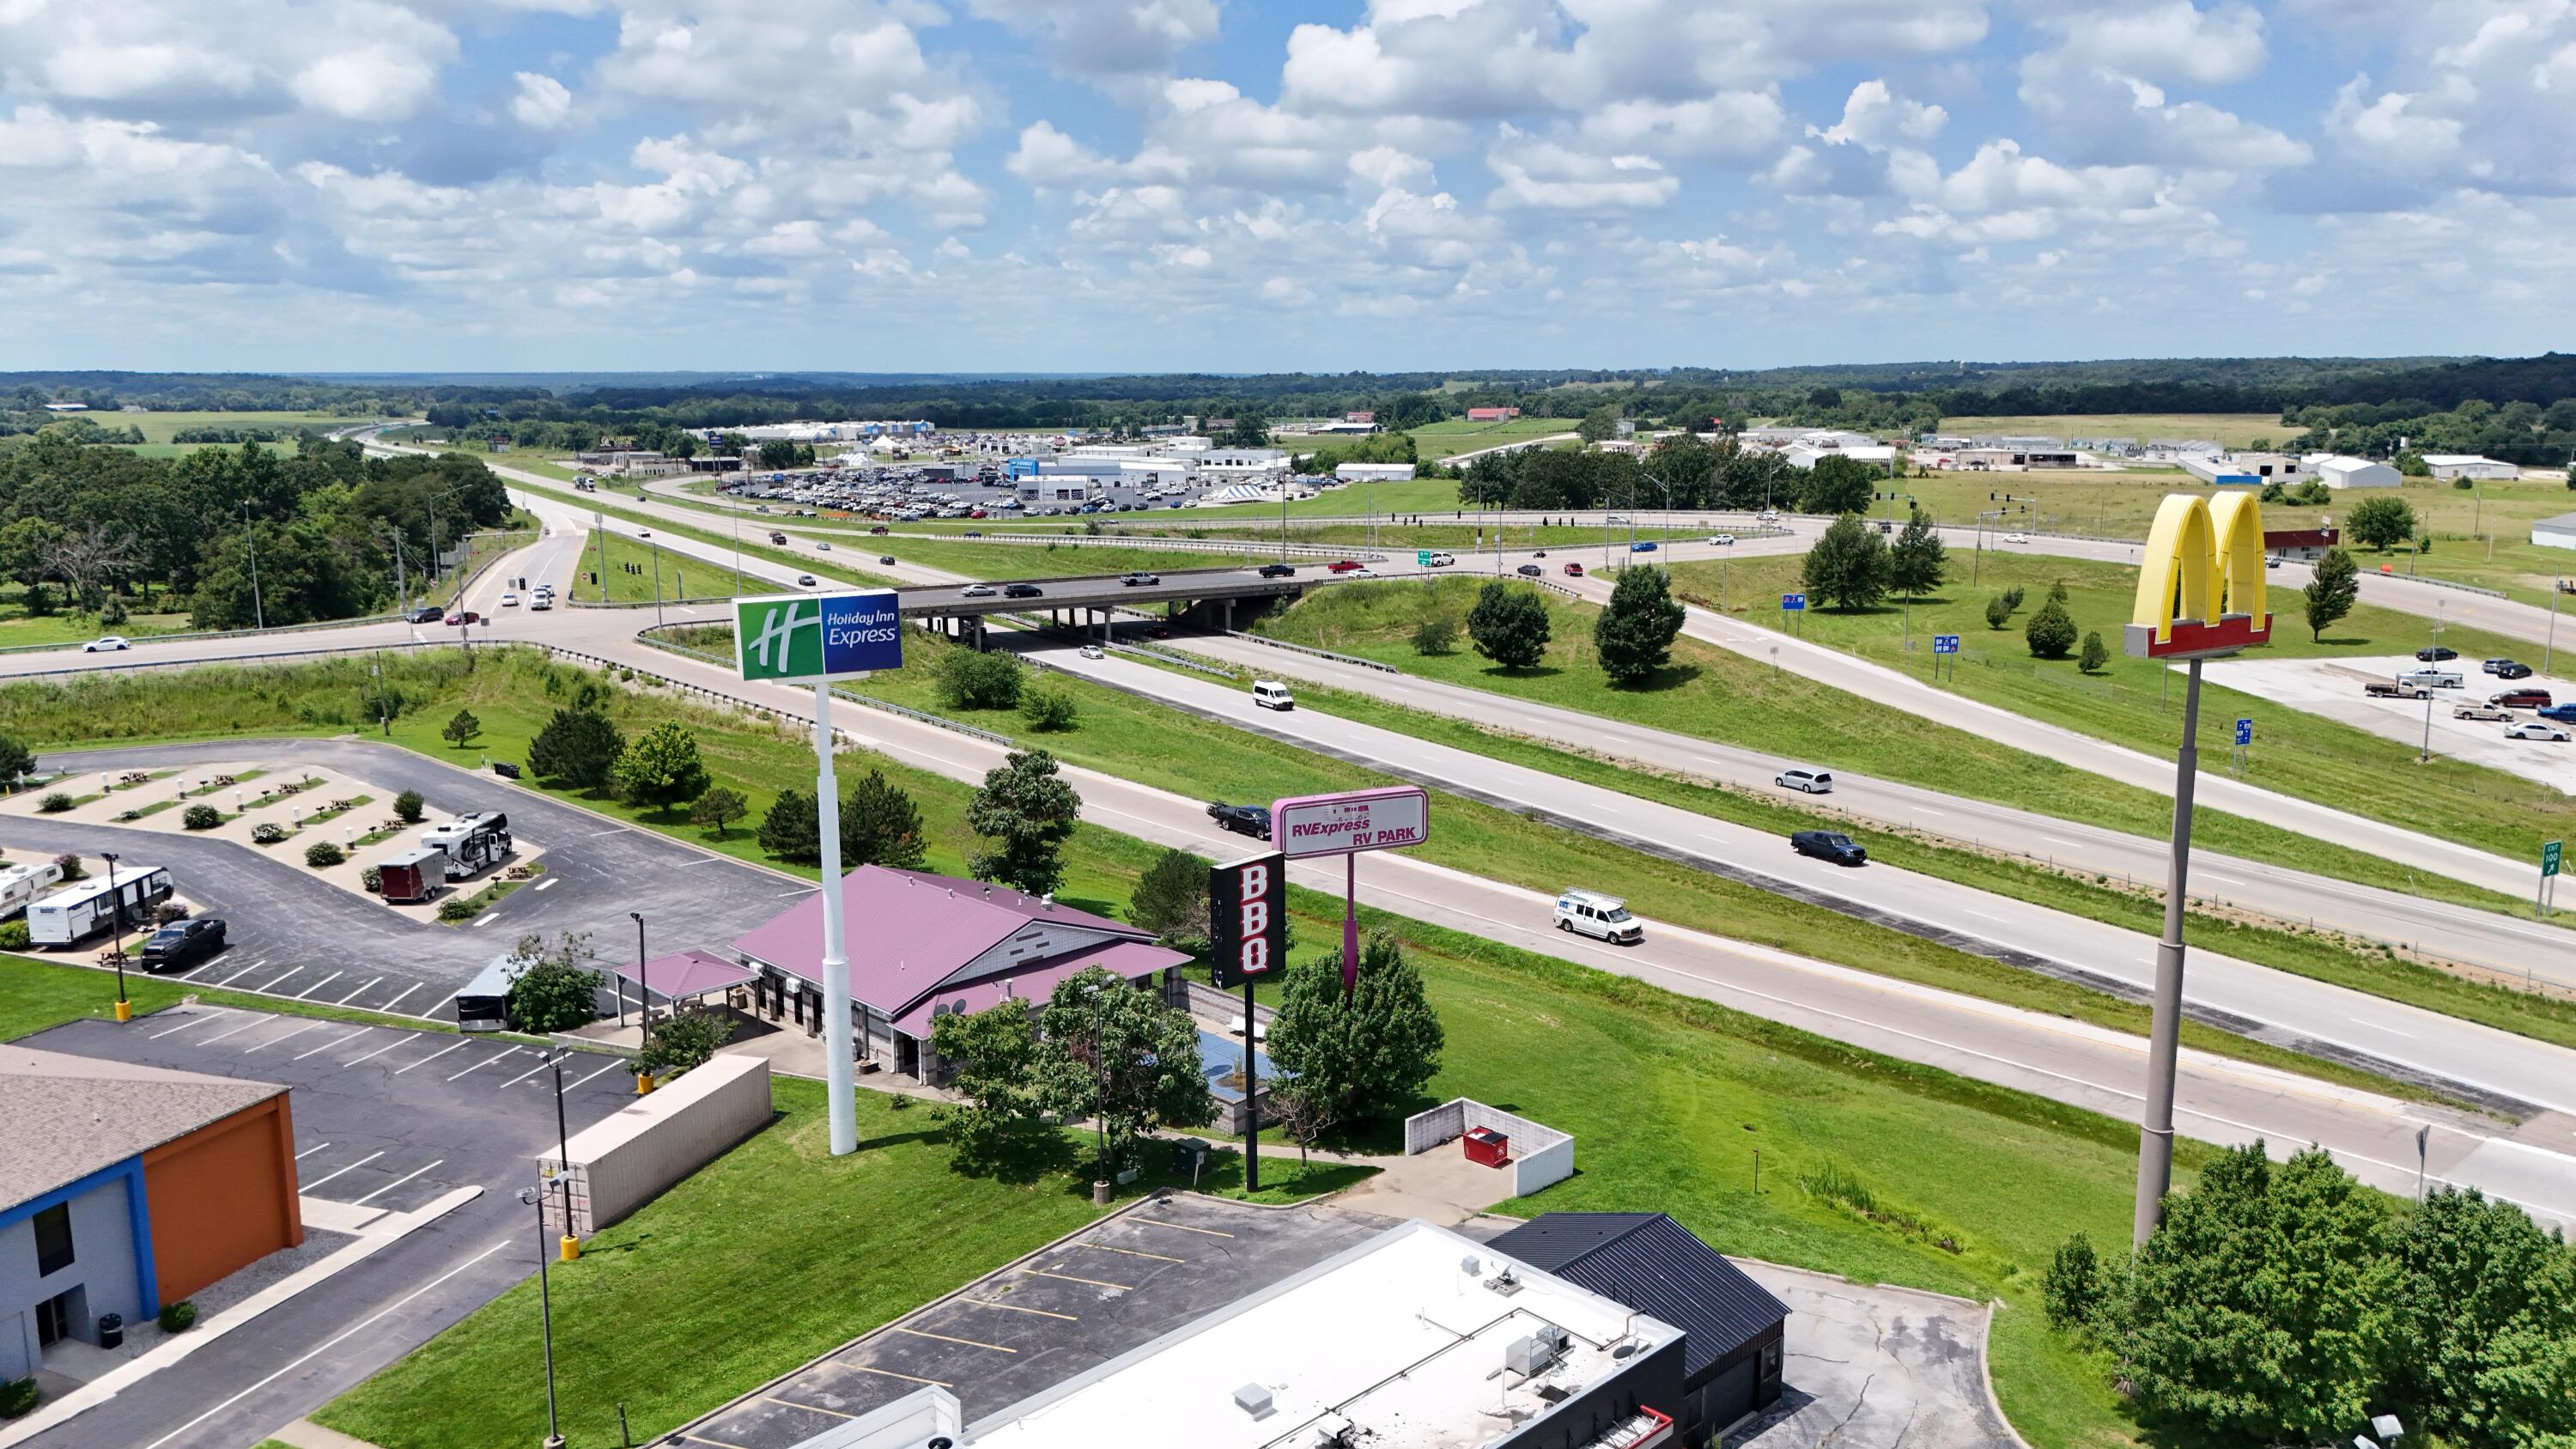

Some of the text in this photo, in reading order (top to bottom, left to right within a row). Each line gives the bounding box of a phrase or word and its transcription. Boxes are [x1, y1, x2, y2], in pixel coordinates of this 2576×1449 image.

[827, 610, 895, 626] Holiday Inn
[829, 628, 895, 648] Express
[1291, 818, 1370, 837] RVExpress
[1352, 826, 1416, 846] RV PARK
[2546, 853, 2558, 863] 100
[1240, 863, 1269, 973] BBQ
